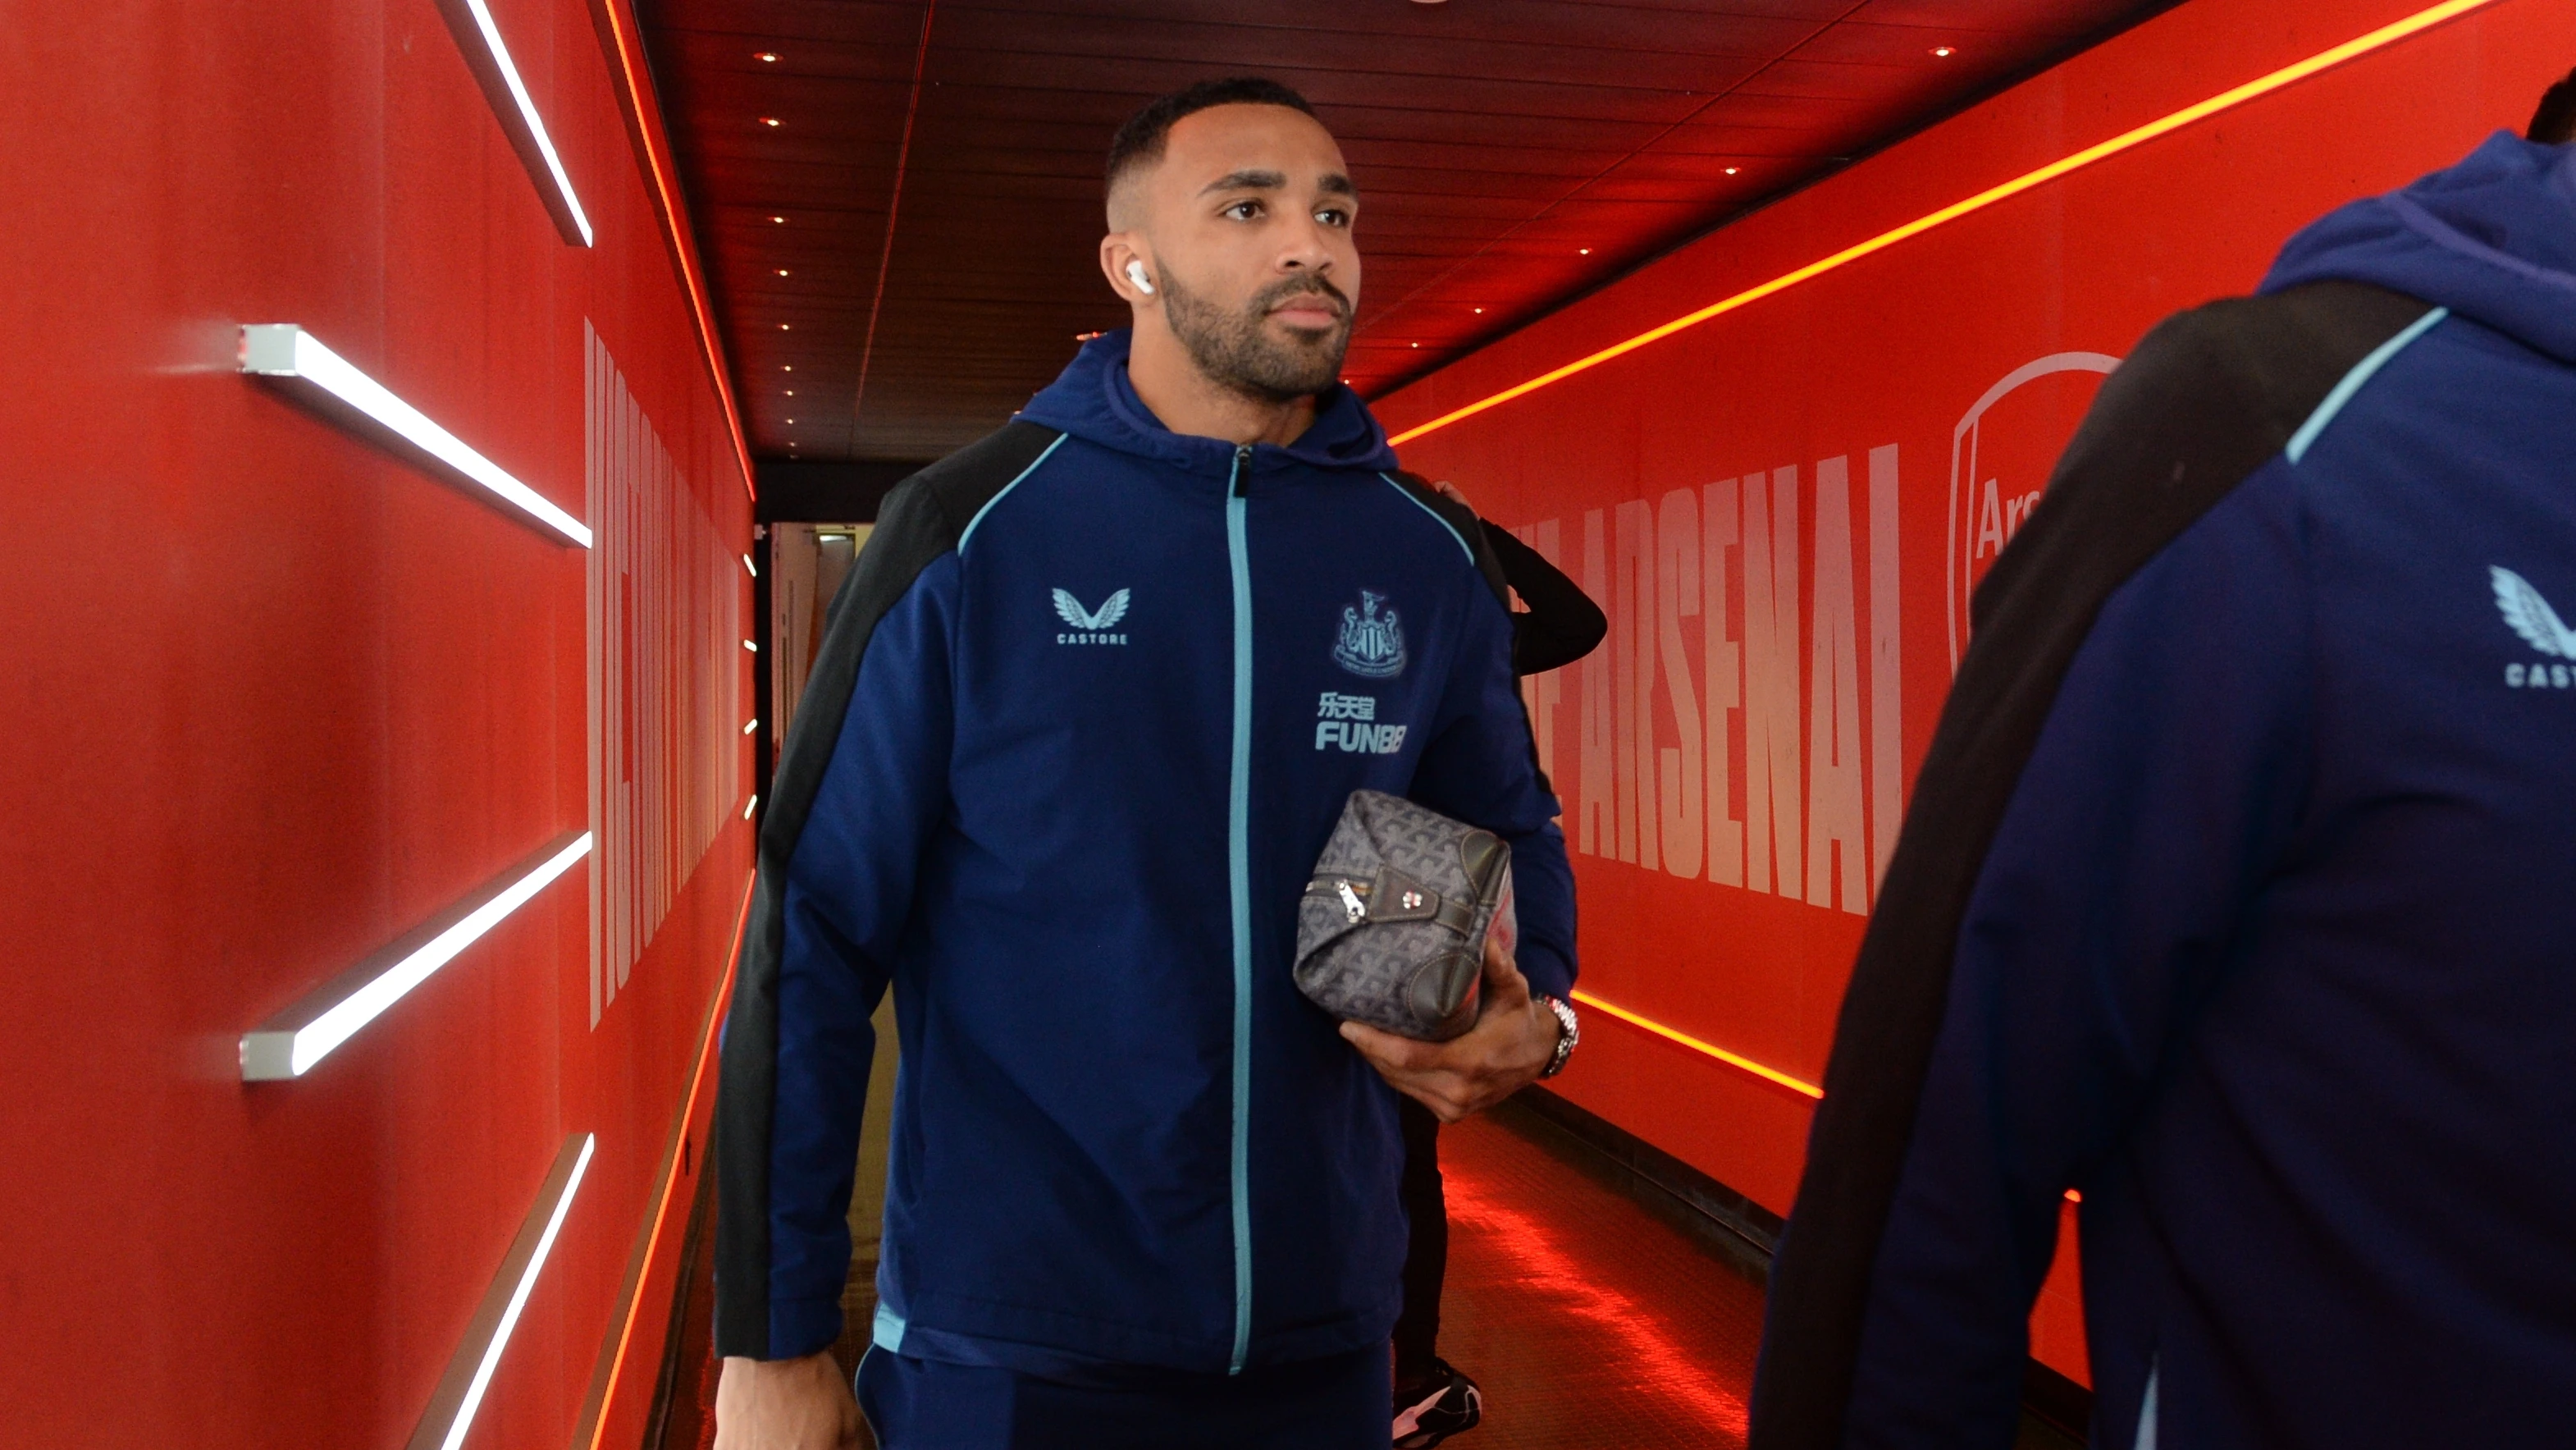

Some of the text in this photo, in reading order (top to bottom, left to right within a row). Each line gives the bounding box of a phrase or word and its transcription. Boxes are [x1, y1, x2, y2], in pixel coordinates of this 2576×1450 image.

[1057, 634, 1127, 645] CASTORE
[2505, 663, 2576, 688] CAS
[1317, 692, 1375, 720] 乐天堂
[1315, 720, 1407, 754] FUN88
